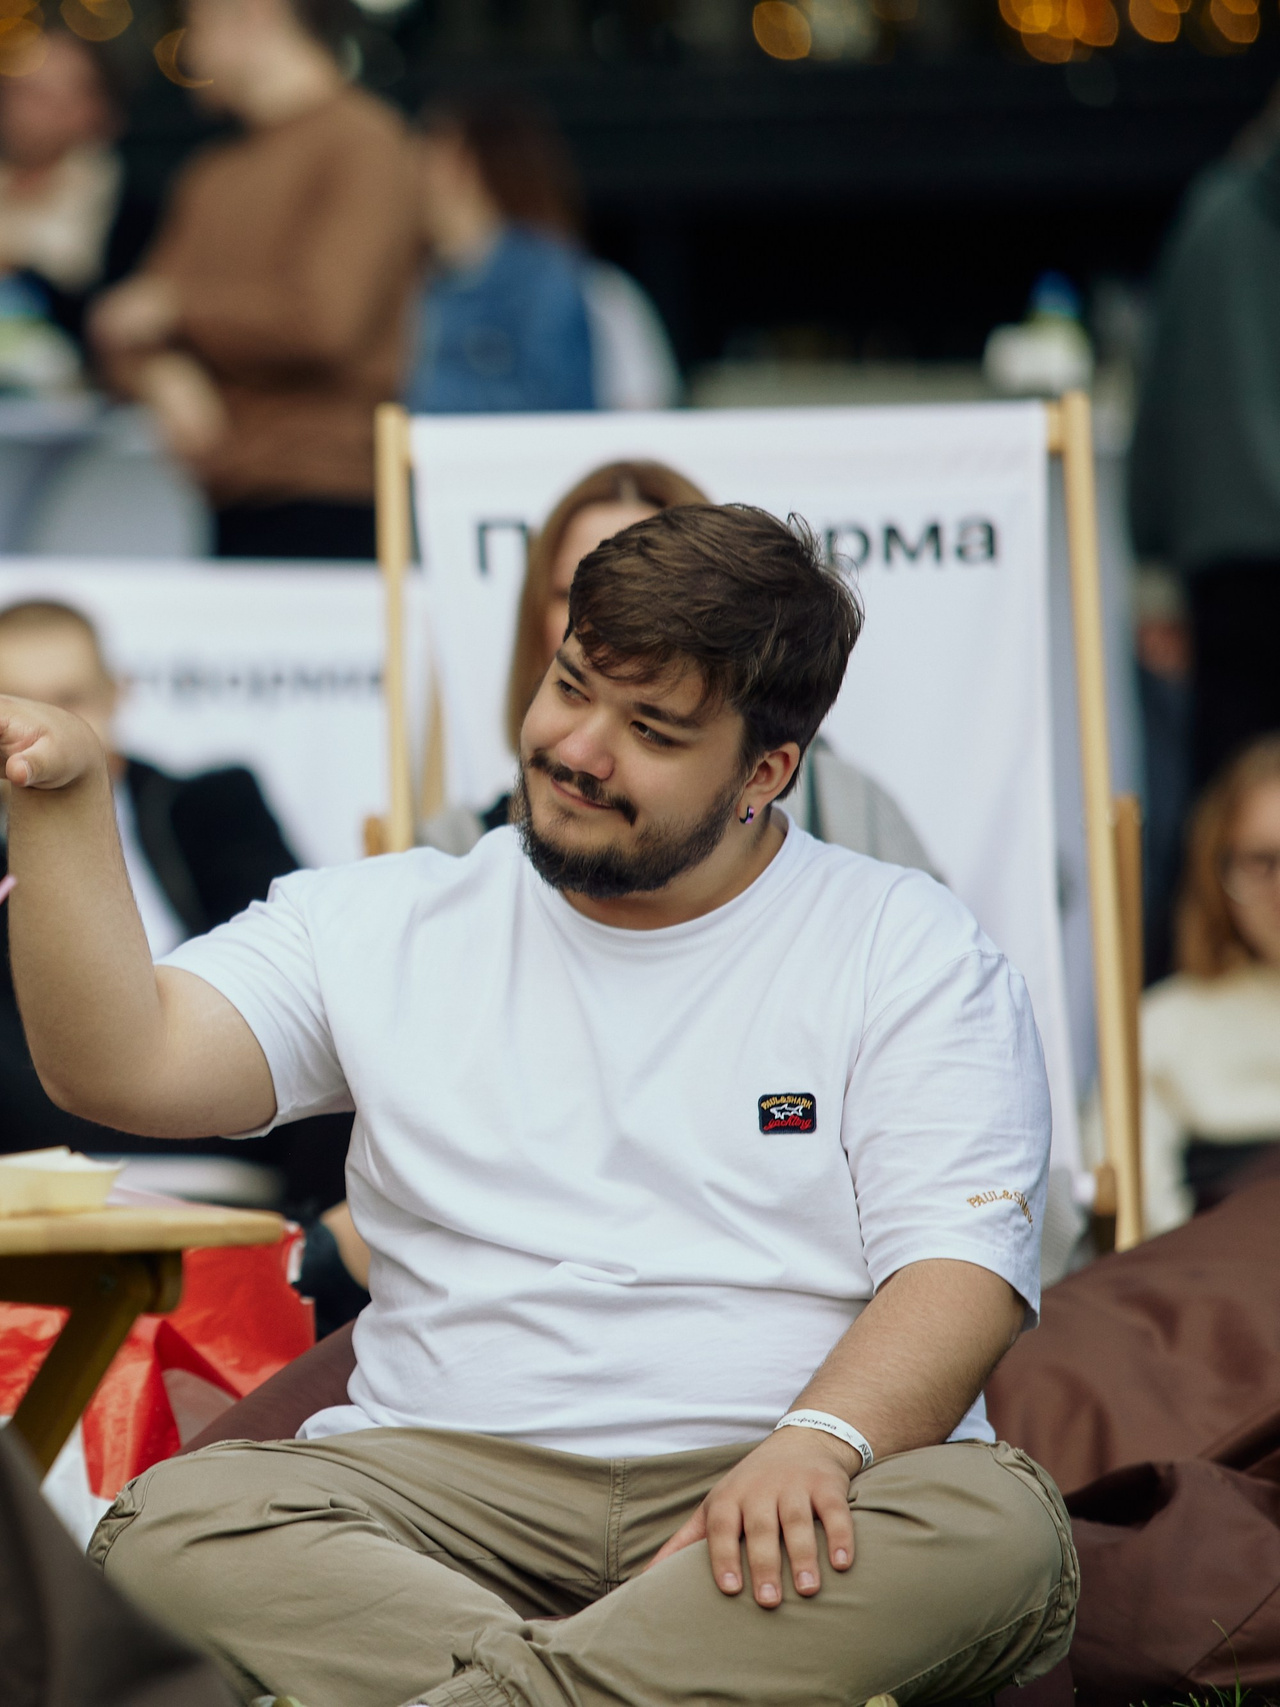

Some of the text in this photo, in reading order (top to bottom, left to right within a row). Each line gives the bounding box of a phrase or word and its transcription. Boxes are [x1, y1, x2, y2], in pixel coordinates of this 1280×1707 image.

[761, 1097, 780, 1110] PAUL
[786, 1096, 813, 1110] SHARK
[966, 1191, 1003, 1208] PAUL
